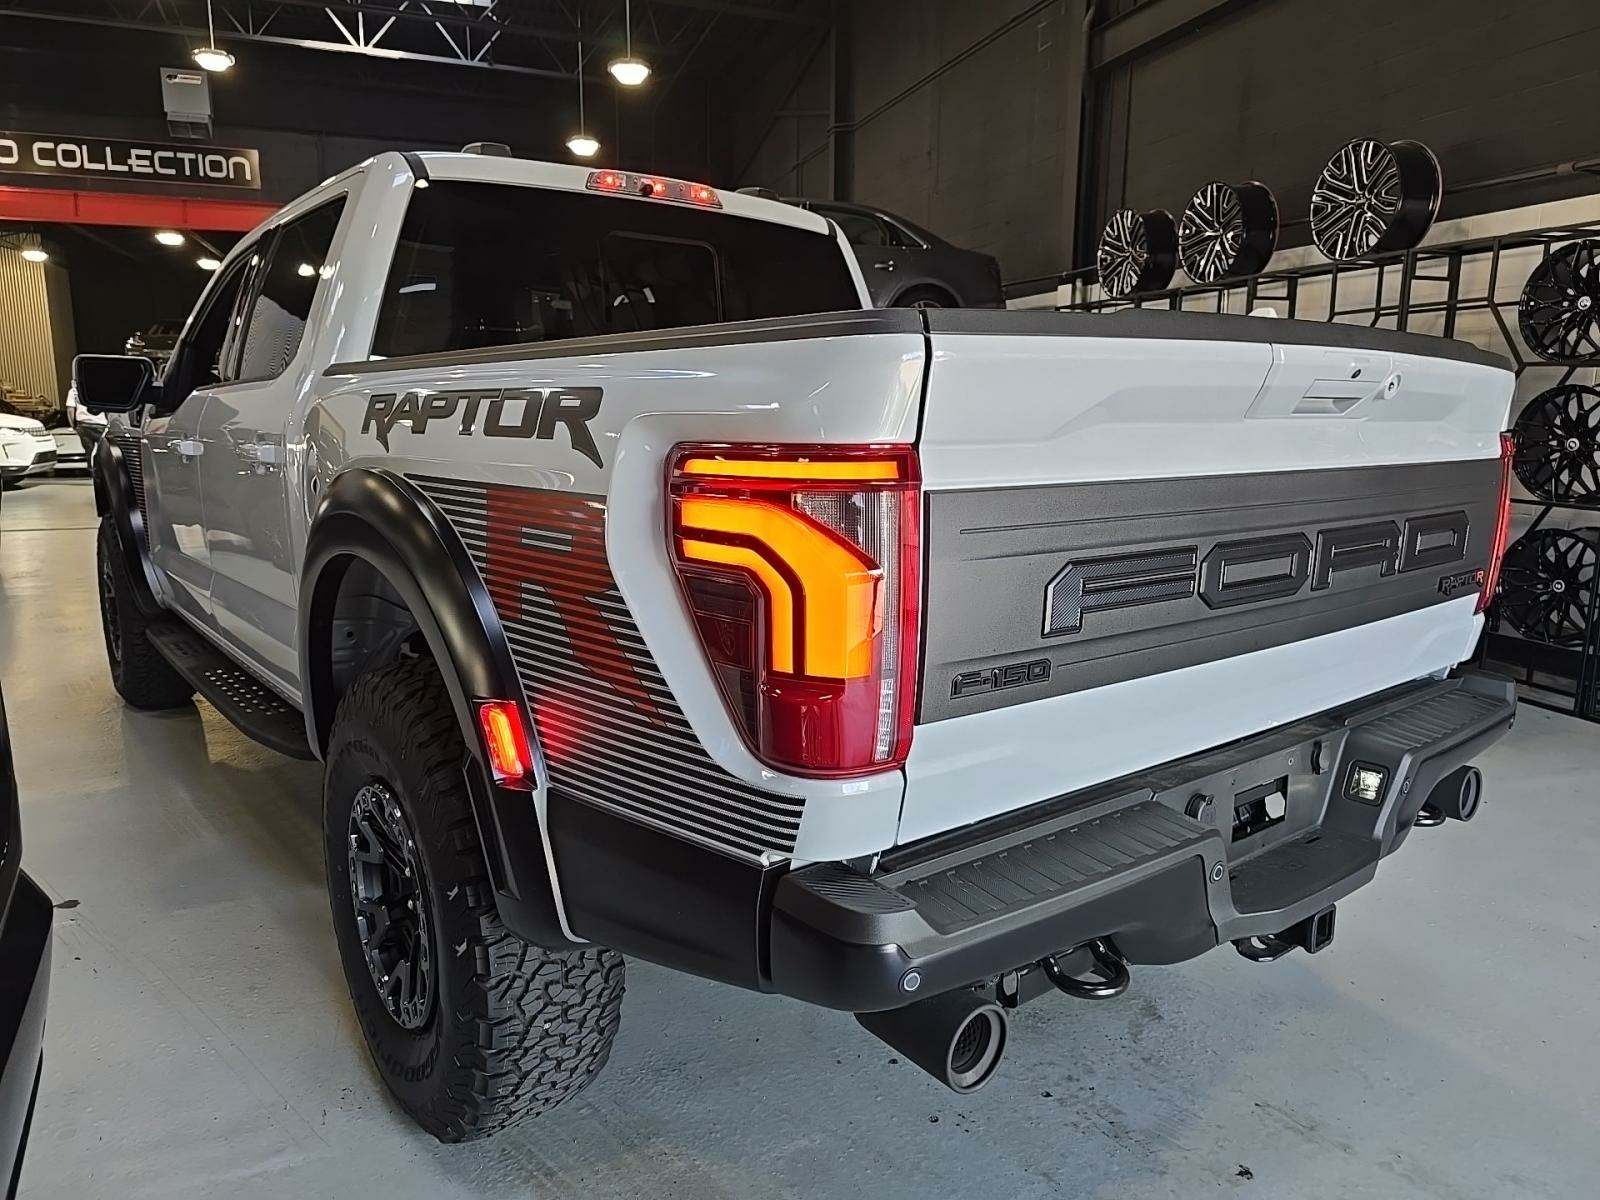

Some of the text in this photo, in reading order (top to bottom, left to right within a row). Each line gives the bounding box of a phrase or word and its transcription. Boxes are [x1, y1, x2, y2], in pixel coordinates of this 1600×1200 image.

[32, 141, 252, 181] COLLECTION
[361, 387, 604, 469] RAPTOR
[1041, 510, 1471, 638] FORD
[1437, 569, 1485, 597] RAPTOR
[950, 658, 1052, 700] F-150
